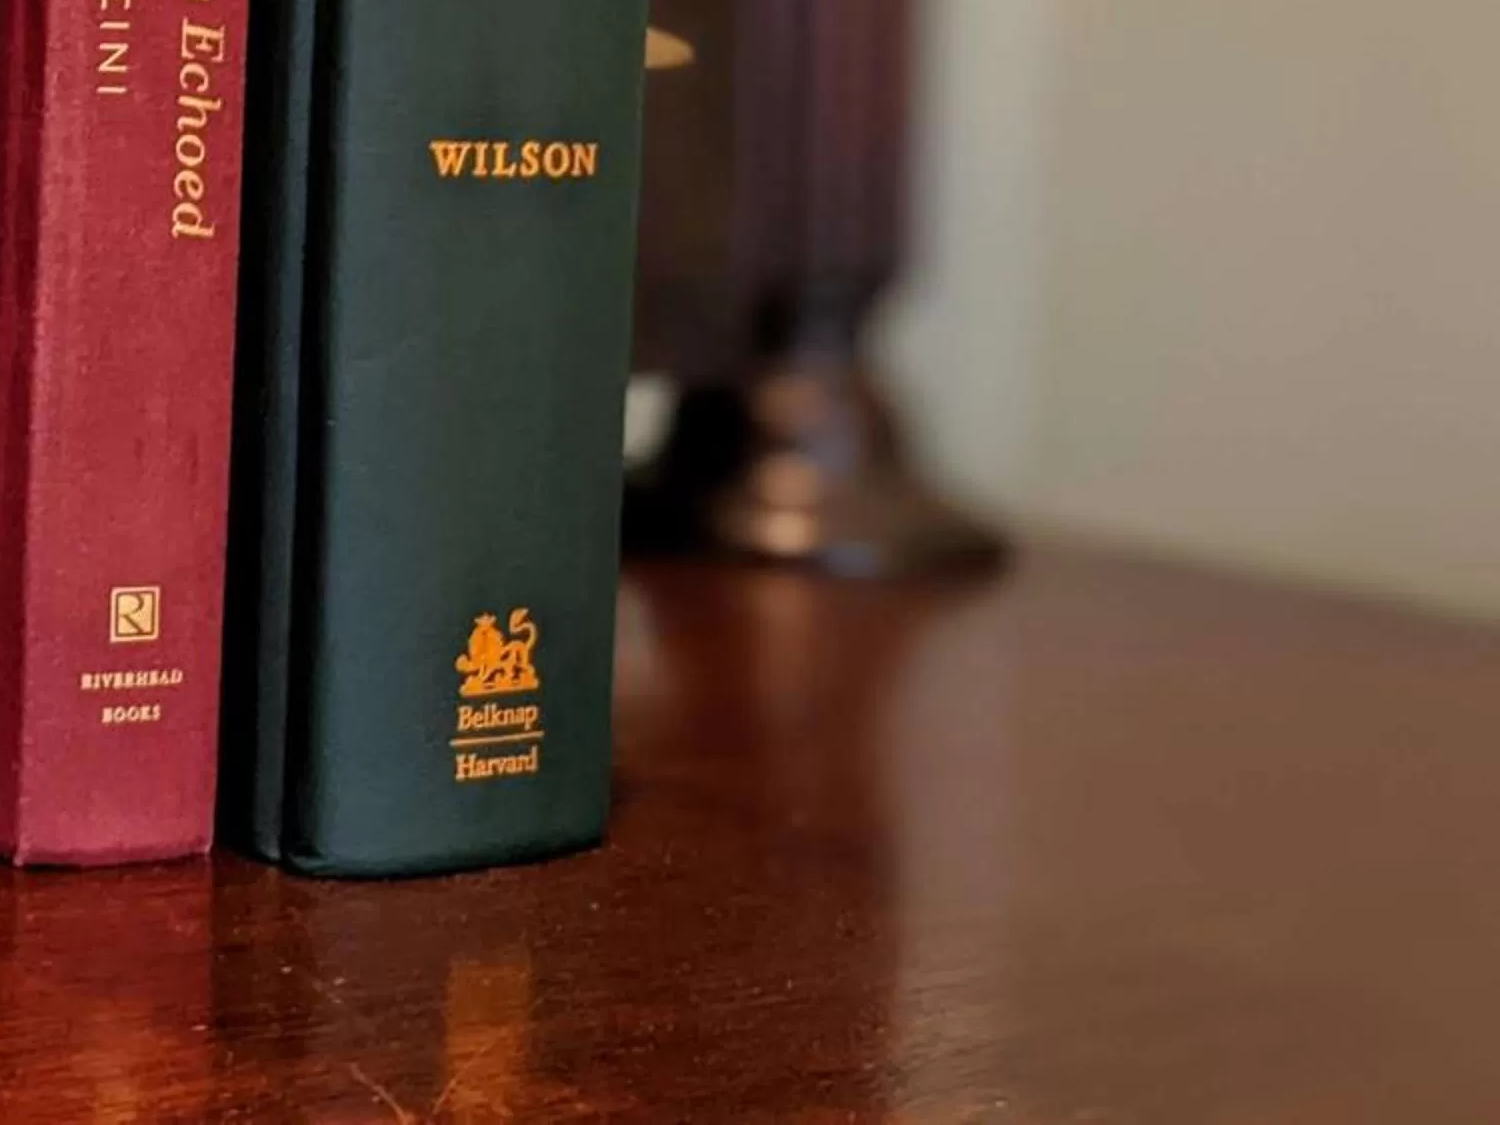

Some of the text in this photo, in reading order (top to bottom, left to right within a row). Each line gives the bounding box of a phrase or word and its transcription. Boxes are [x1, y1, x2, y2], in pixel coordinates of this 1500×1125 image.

[171, 16, 225, 239] Echoed
[429, 140, 599, 179] WILSON
[80, 668, 185, 691] RIVERHEAD
[101, 704, 162, 724] BOOKS
[456, 703, 539, 731] Belknap
[455, 746, 540, 781] Harvard
